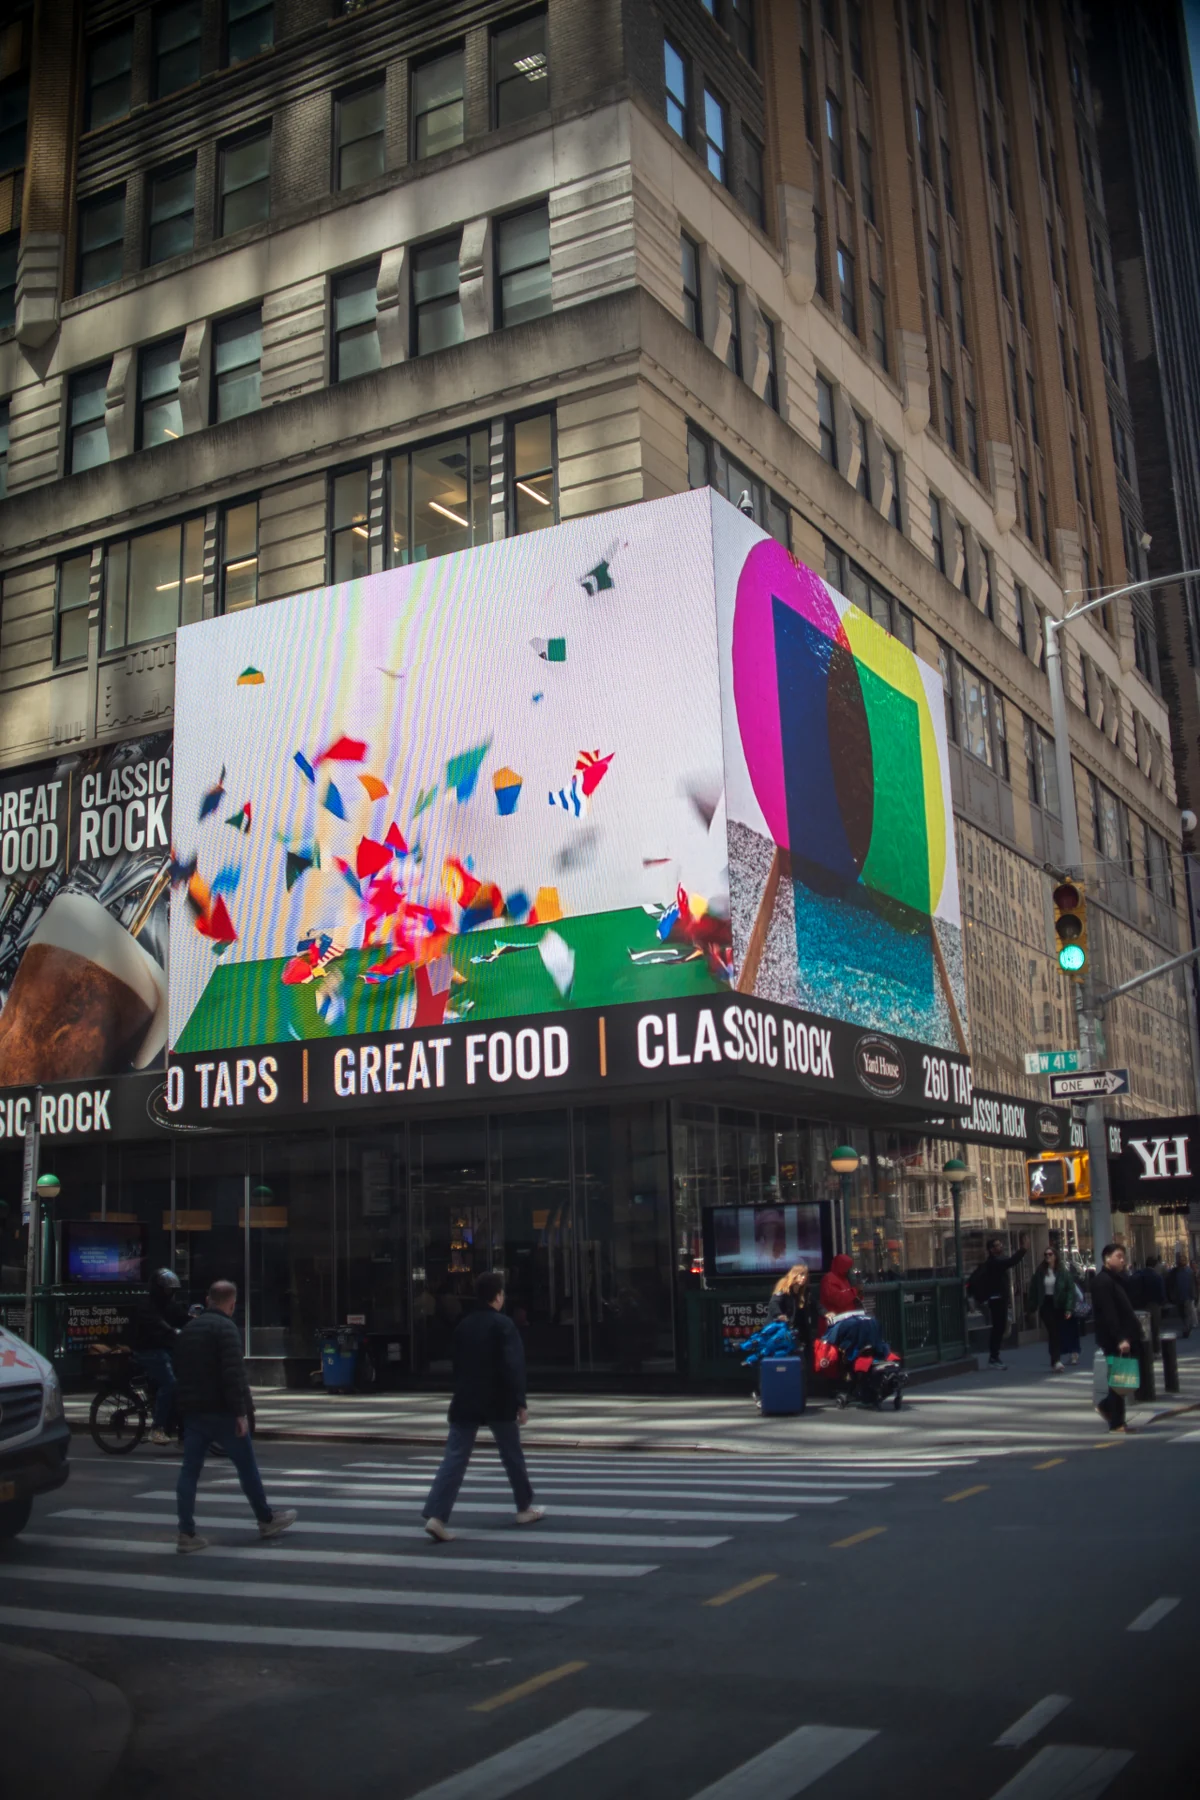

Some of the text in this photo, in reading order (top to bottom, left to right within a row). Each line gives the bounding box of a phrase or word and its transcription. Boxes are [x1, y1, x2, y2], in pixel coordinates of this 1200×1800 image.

[81, 757, 171, 808] CLASSIC
[0, 781, 62, 831] REAT
[79, 794, 169, 861] ROCK
[0, 822, 58, 876] OOD
[334, 1026, 569, 1096] GREAT FOOD
[637, 1005, 835, 1079] CLASSIC ROCK
[1040, 1055, 1049, 1070] W
[1053, 1054, 1066, 1069] 41
[1068, 1053, 1077, 1064] St
[195, 1055, 278, 1109] TAPS
[862, 1052, 900, 1079] Yard House
[923, 1055, 949, 1102] 260
[1061, 1077, 1117, 1092] ONE WAY
[40, 1089, 111, 1135] ROCK
[1002, 1103, 1027, 1138] ROCK
[1128, 1136, 1193, 1179] YH
[68, 1306, 117, 1317] Times Square
[68, 1315, 130, 1326] 42 Street Station
[722, 1303, 752, 1315] Times
[722, 1315, 766, 1326] 42 Stree
